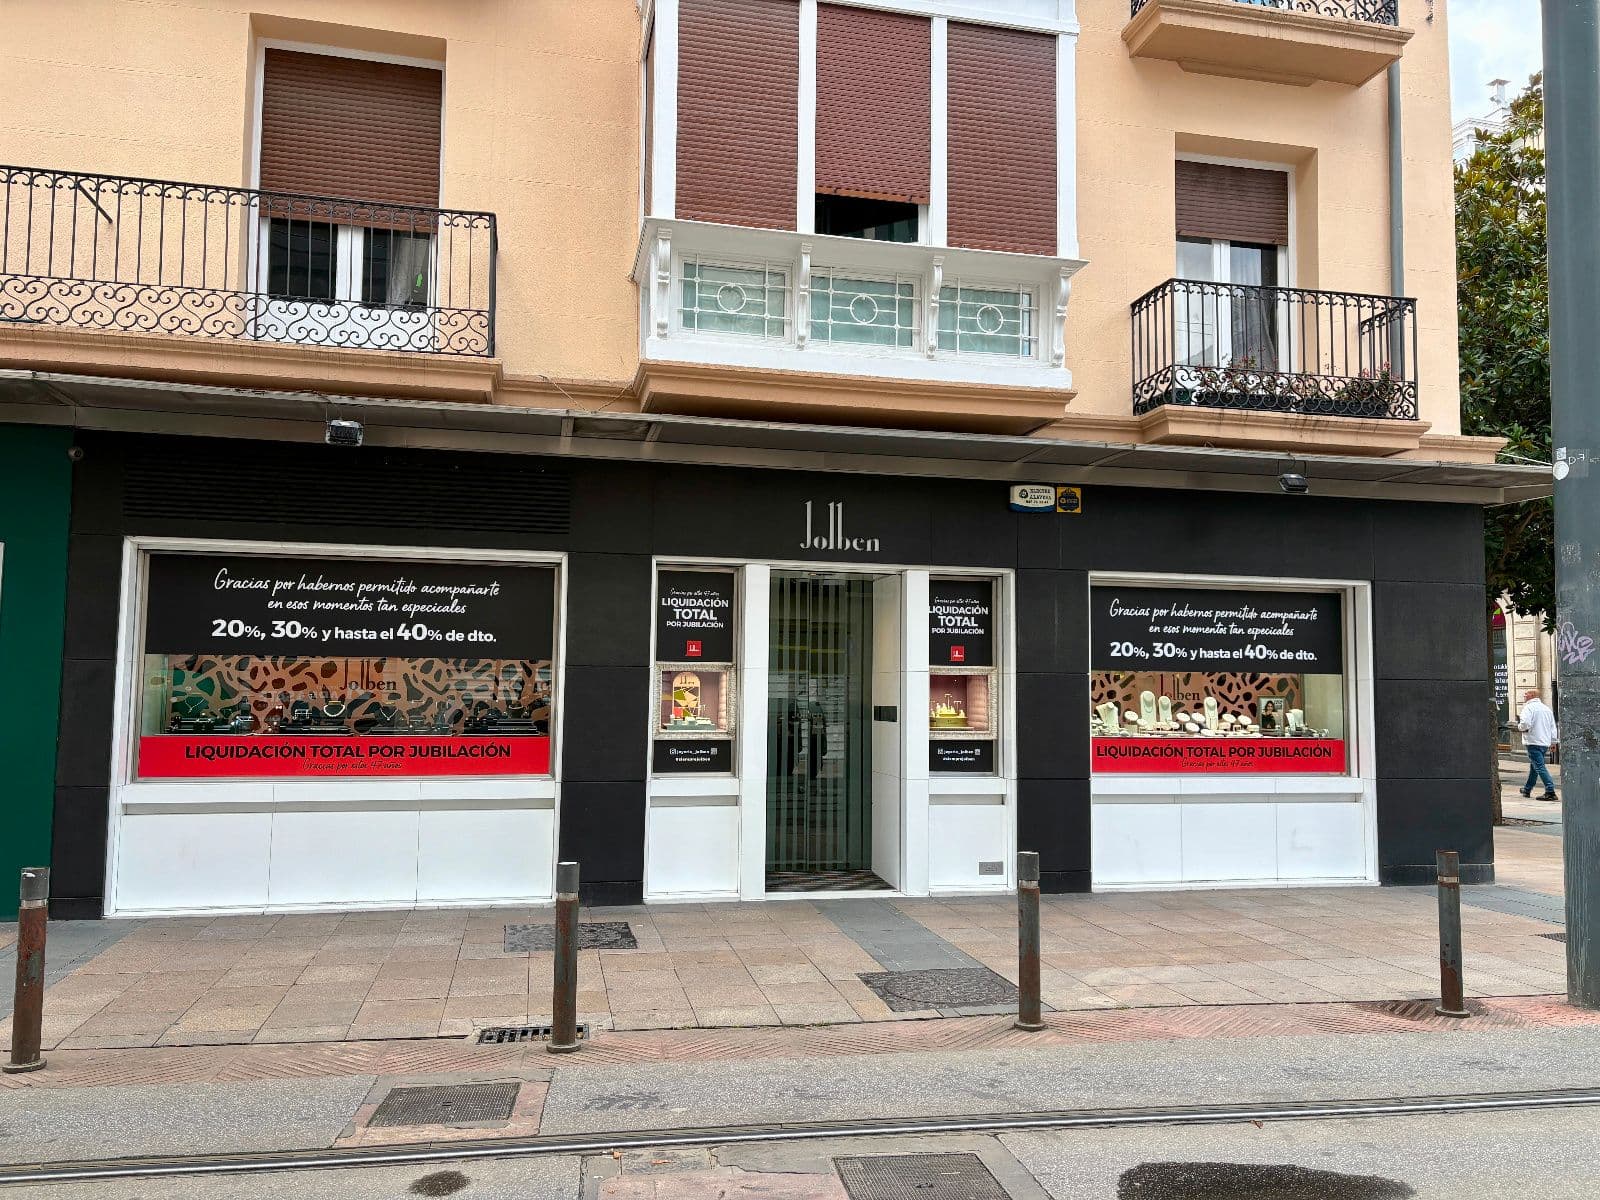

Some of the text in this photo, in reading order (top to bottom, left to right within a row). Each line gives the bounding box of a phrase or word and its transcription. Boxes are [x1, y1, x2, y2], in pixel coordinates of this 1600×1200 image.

[800, 500, 880, 552] Jolben
[214, 568, 500, 600] Gracias por habernos permitido acompañarte
[267, 597, 467, 618] en esos momentos tan especicales
[661, 597, 729, 608] LIQUIDACIÓN
[1109, 598, 1319, 624] Gracias por habernos permitido acompañarte
[673, 608, 717, 620] TOTAL
[938, 616, 978, 627] TOTAL
[211, 619, 497, 642] 20%, 30% y hasta el 40% de dto.
[682, 621, 724, 629] JUBILACIÓN
[946, 627, 985, 635] JUBILACIÓN
[1149, 625, 1161, 633] en
[1163, 625, 1180, 633] esos
[1183, 622, 1228, 634] momentos
[1229, 622, 1245, 635] tan
[1110, 641, 1318, 661] 20%, 30% y hasta el 40% de dto.
[340, 658, 397, 691] Jolben
[185, 741, 511, 761] LIQUIDACIÓN TOTAL POR JUBILACIÓN
[1096, 744, 1332, 759] LIQUIDACIÓN TOTAL POR JUBILACIÓN
[303, 758, 334, 770] Gracias
[336, 762, 349, 773] por
